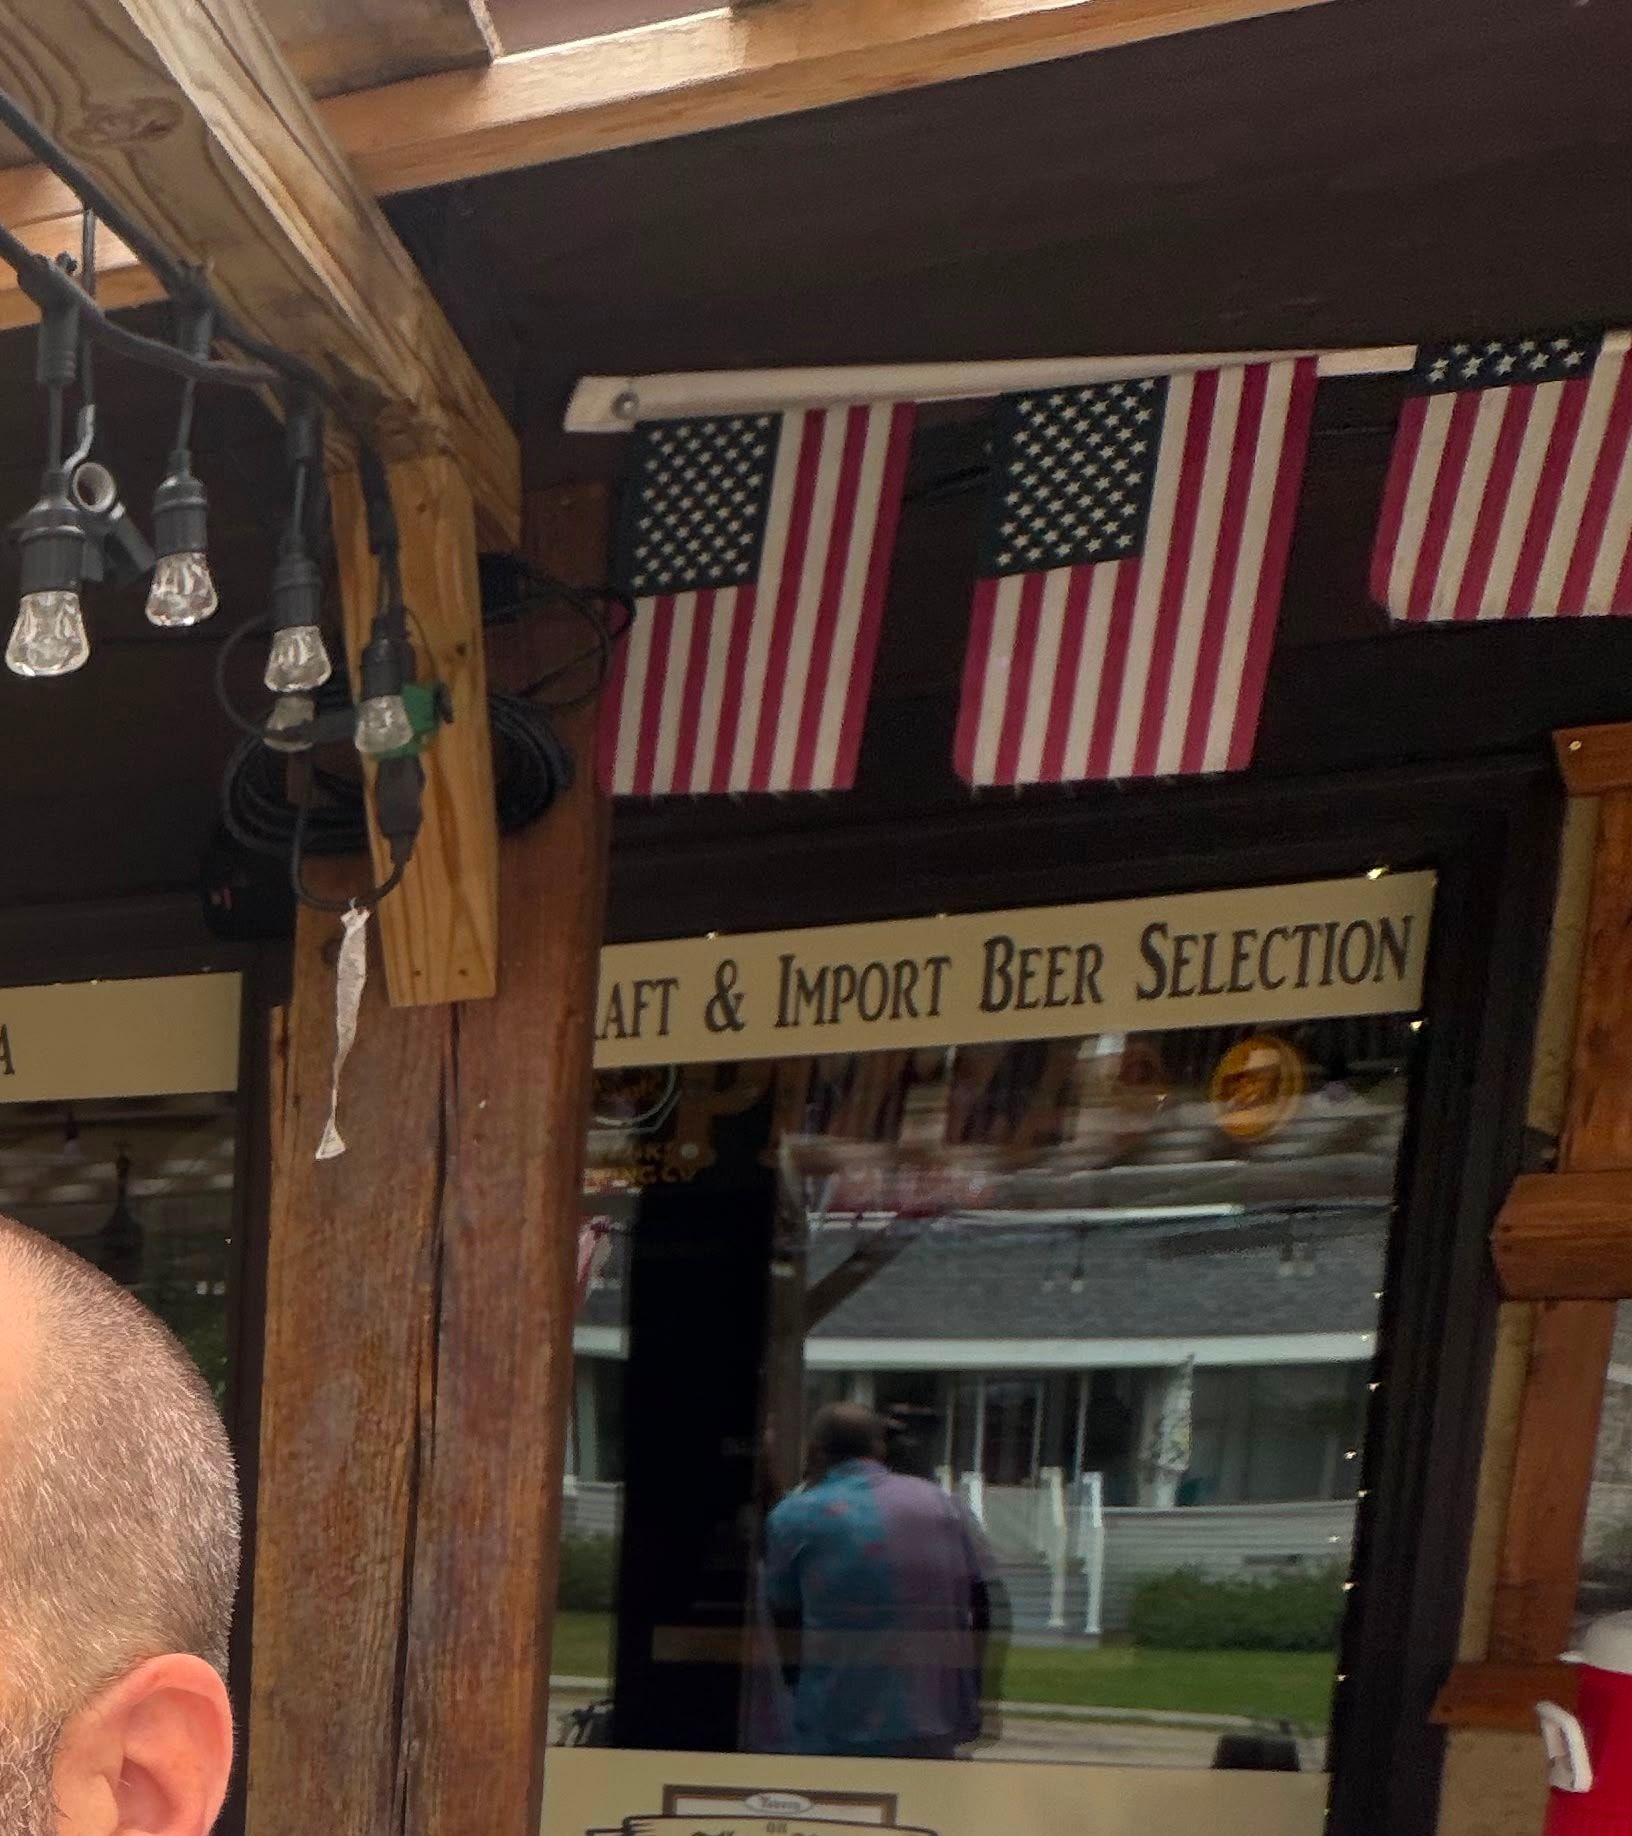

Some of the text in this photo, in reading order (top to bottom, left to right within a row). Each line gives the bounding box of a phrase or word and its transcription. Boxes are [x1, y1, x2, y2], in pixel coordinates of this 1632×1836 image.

[594, 915, 1416, 1039] AFT & IMPORT BEER SELECTION
